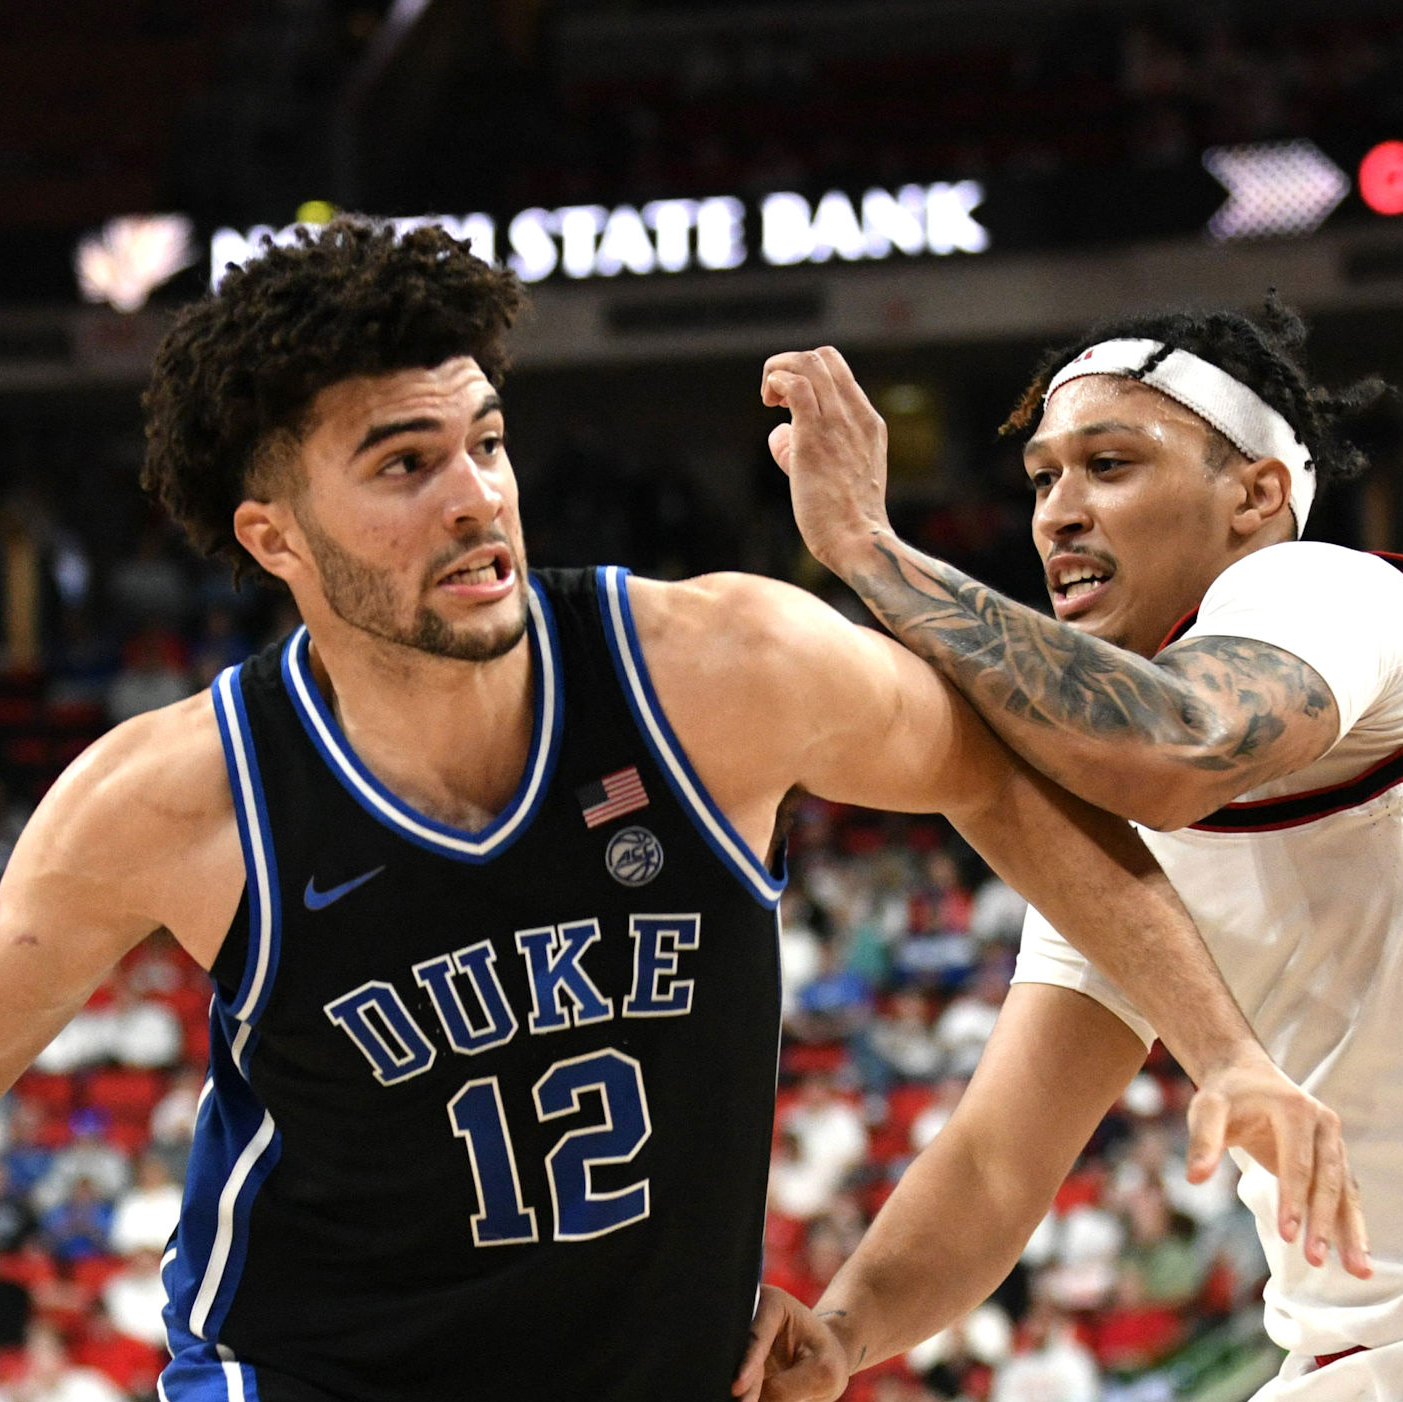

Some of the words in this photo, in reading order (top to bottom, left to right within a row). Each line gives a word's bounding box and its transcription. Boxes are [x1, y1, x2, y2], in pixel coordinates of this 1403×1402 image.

[508, 196, 747, 283] STATE
[762, 180, 990, 266] BANK
[323, 912, 701, 1086] DUKE
[447, 1047, 652, 1247] 12
